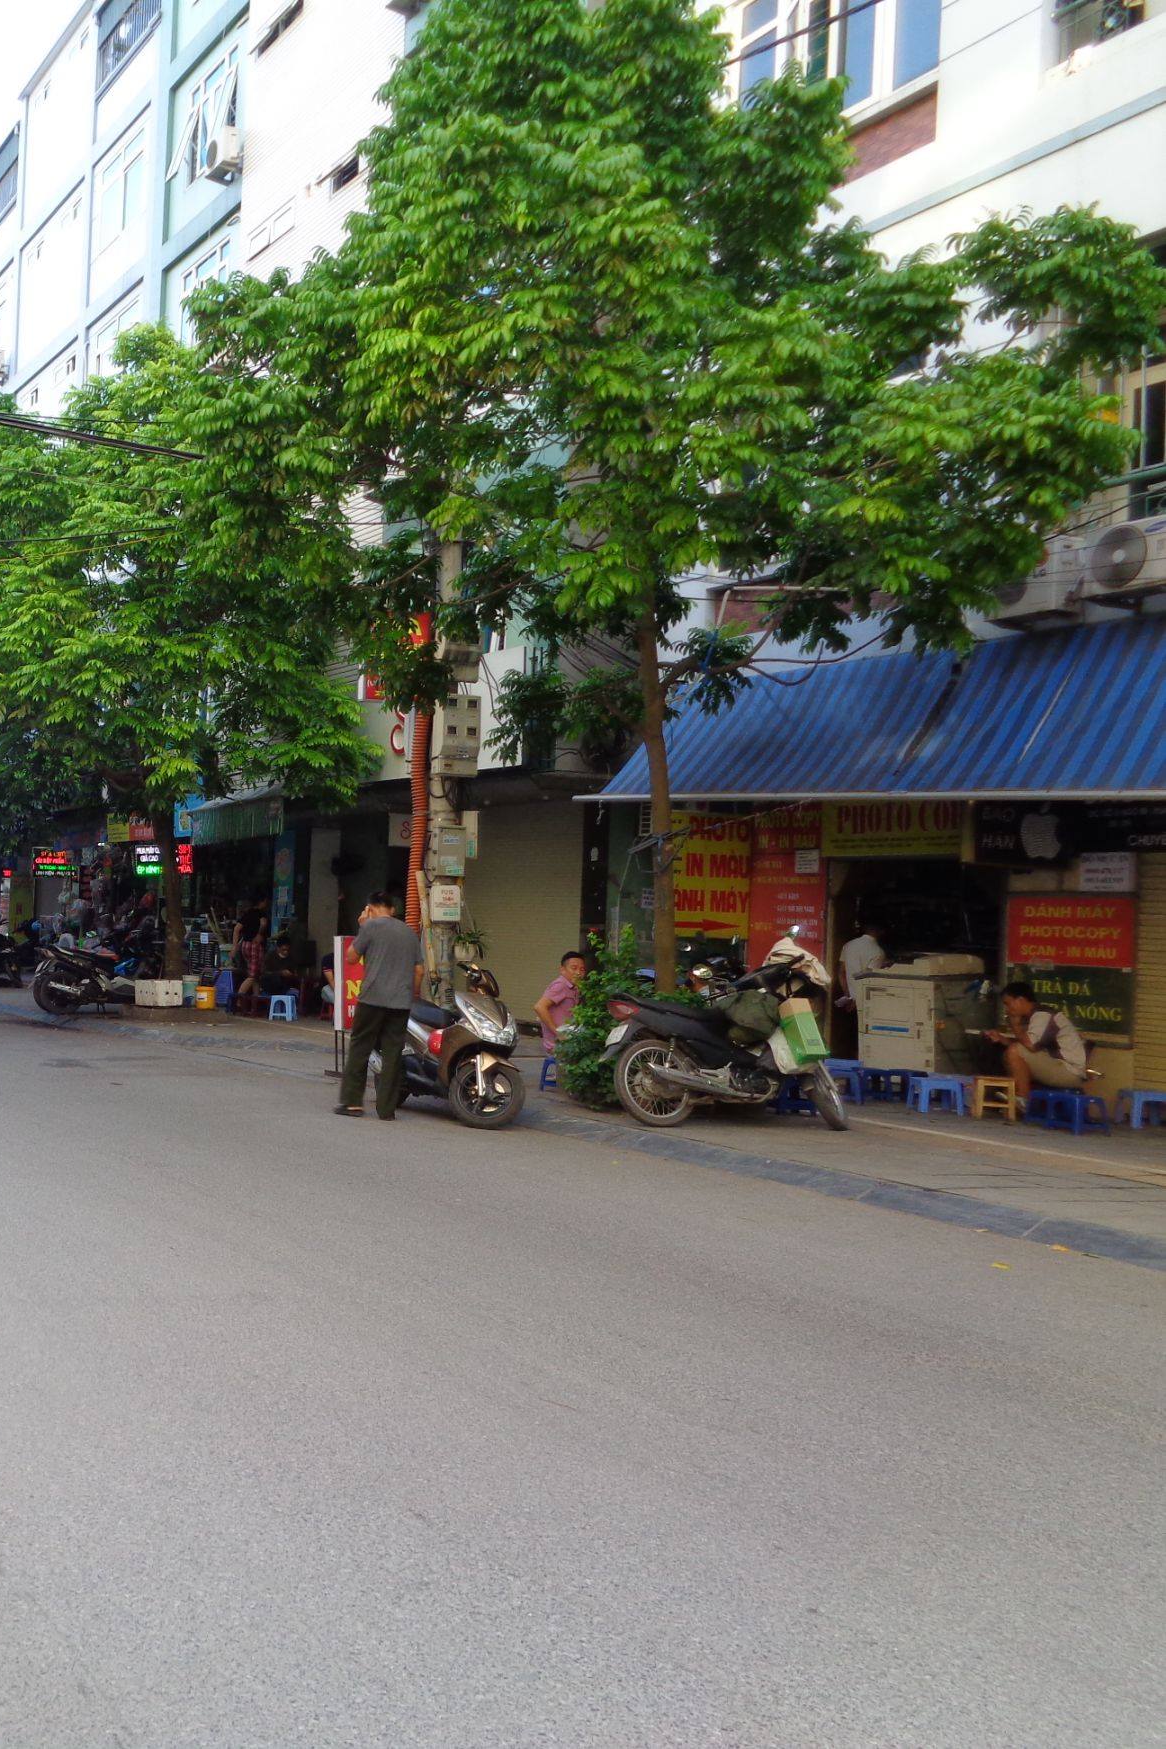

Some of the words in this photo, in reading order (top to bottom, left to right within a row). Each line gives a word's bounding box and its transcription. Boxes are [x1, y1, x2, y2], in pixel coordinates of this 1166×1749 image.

[837, 801, 912, 835] PHOTO
[685, 853, 704, 877] IN
[673, 884, 705, 912] ÁNH
[710, 885, 750, 914] MÁY
[1018, 924, 1122, 941] PHOTOCOPY
[1032, 976, 1063, 995] TRÀ
[1075, 1002, 1123, 1022] NÓNG
